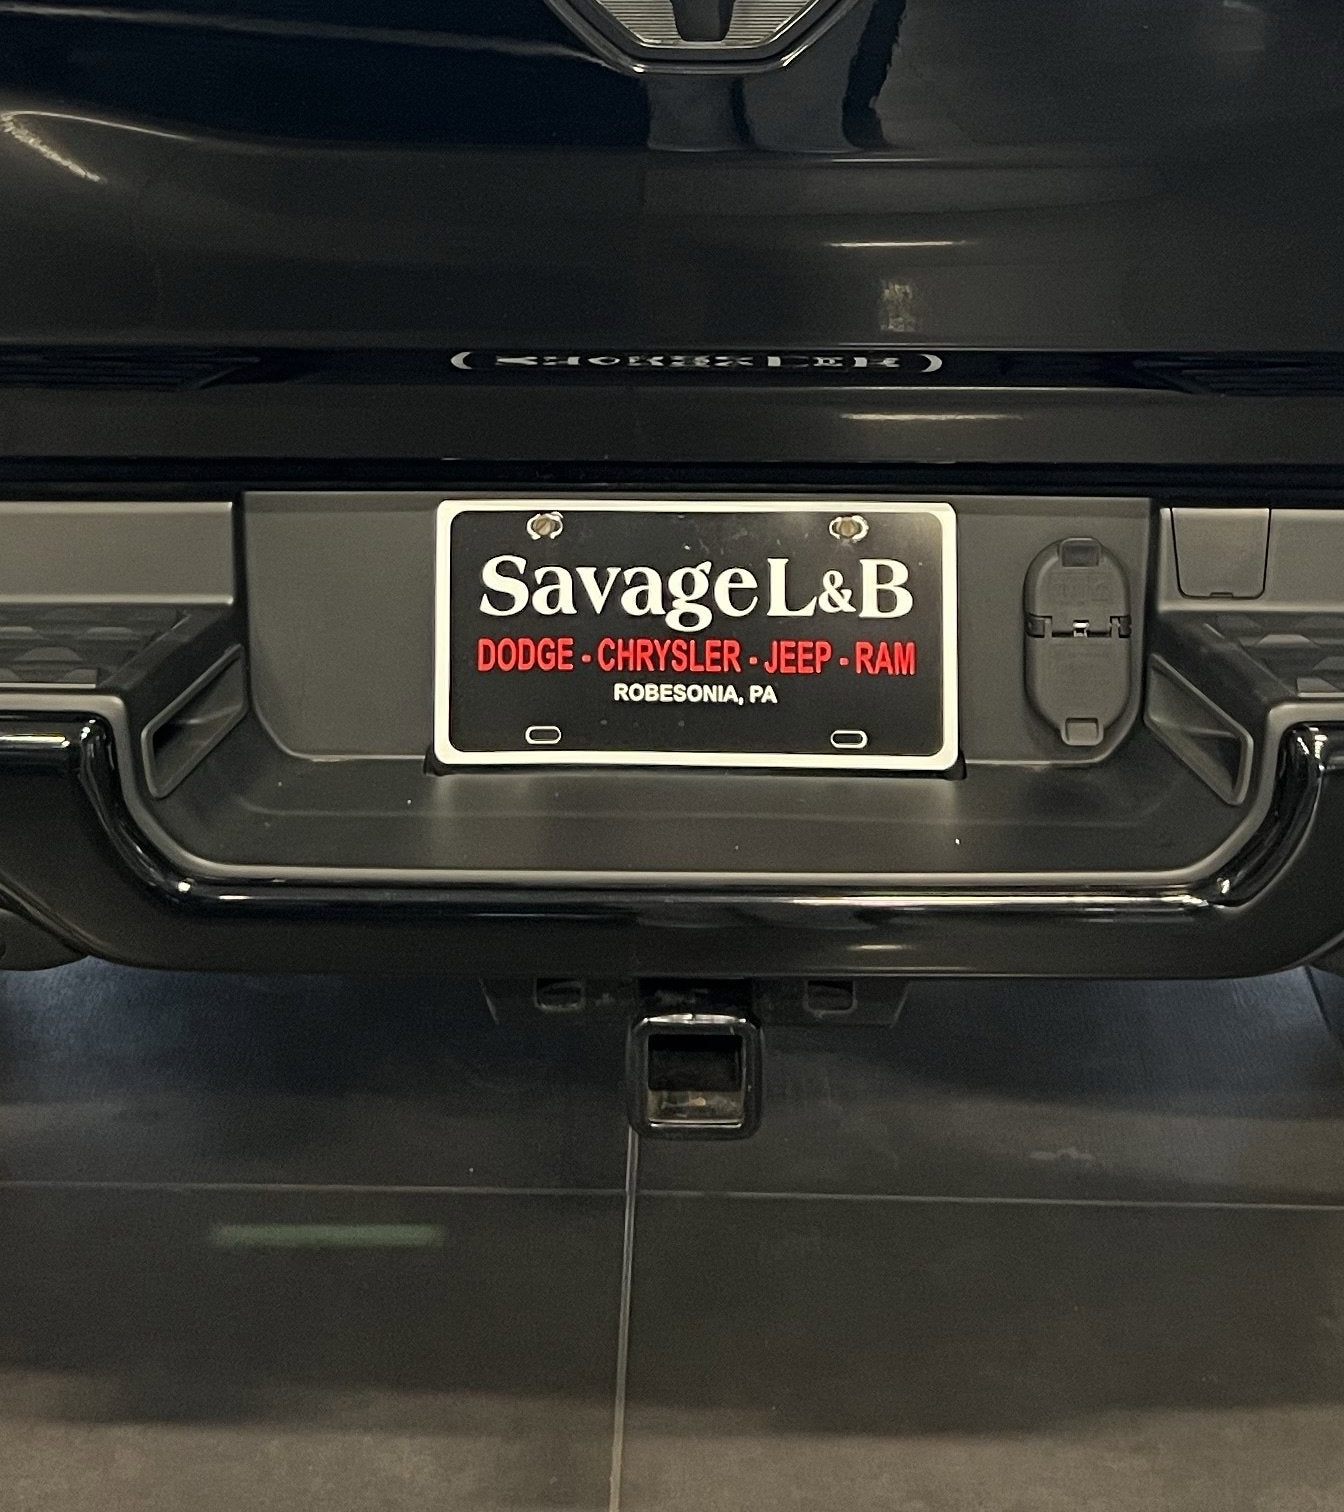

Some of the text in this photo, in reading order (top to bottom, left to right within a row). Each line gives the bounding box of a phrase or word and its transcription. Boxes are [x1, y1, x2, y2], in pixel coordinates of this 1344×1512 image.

[477, 637, 916, 675] DODGE CHRYSLER JEEP RAM
[613, 683, 778, 706] ROBESONIA, PA
